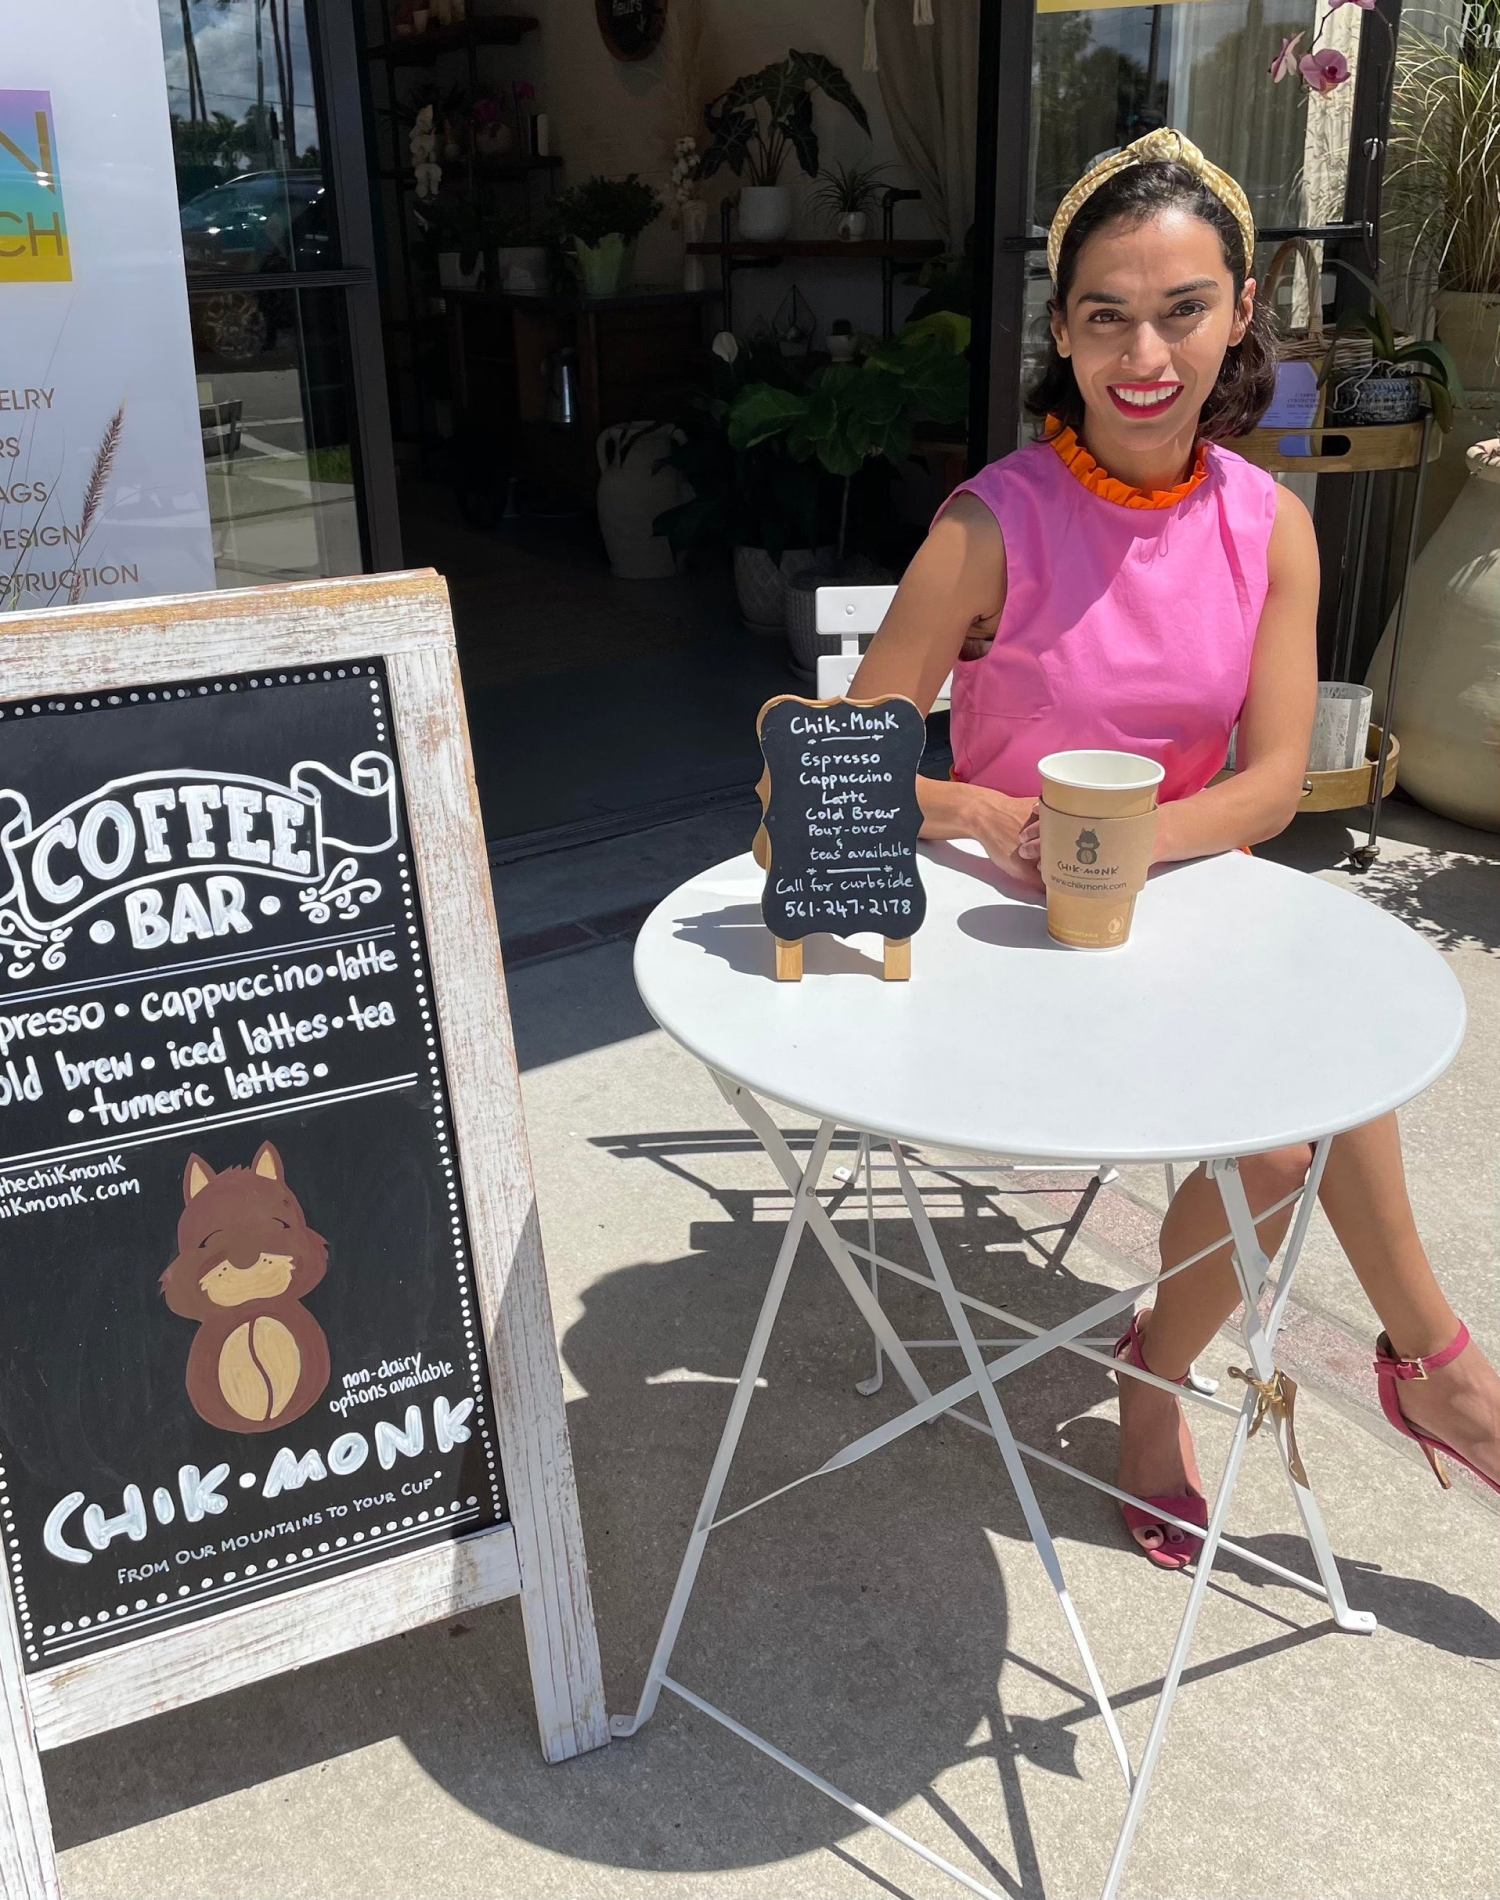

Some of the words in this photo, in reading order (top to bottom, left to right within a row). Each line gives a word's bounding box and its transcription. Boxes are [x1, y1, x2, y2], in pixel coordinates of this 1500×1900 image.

[0, 388, 55, 411] ELRY
[0, 525, 82, 550] ESIGN
[801, 752, 880, 772] Espresso
[800, 771, 893, 790] Cappuccino
[822, 791, 867, 804] Latte
[805, 807, 844, 820] Cold
[852, 806, 900, 820] Brew
[32, 784, 311, 904] COFFEE
[810, 846, 841, 860] teas
[848, 842, 912, 860] available
[776, 878, 804, 894] Call
[809, 877, 834, 893] for
[840, 872, 914, 890] curbside
[1051, 874, 1126, 890] www.chikmonk.com
[125, 875, 253, 949] BAR
[0, 1001, 105, 1056] presso
[141, 964, 323, 1024] cappuccino
[336, 941, 398, 982] latte
[0, 1055, 43, 1106] old
[54, 1050, 133, 1091] brew
[166, 1026, 227, 1070] iced
[237, 1011, 329, 1055] lattes
[347, 995, 396, 1031] tea
[89, 1081, 215, 1126] tumeric
[224, 1060, 310, 1100] lattes
[342, 1352, 421, 1389] non-dairy
[329, 1383, 388, 1418] options
[389, 1360, 454, 1394] available
[117, 1559, 170, 1585] FROM
[175, 1544, 216, 1565] OUR
[221, 1512, 323, 1552] MOUNTAINS
[326, 1504, 348, 1519] TO
[352, 1491, 396, 1512] YOUR
[401, 1477, 434, 1496] CUP
